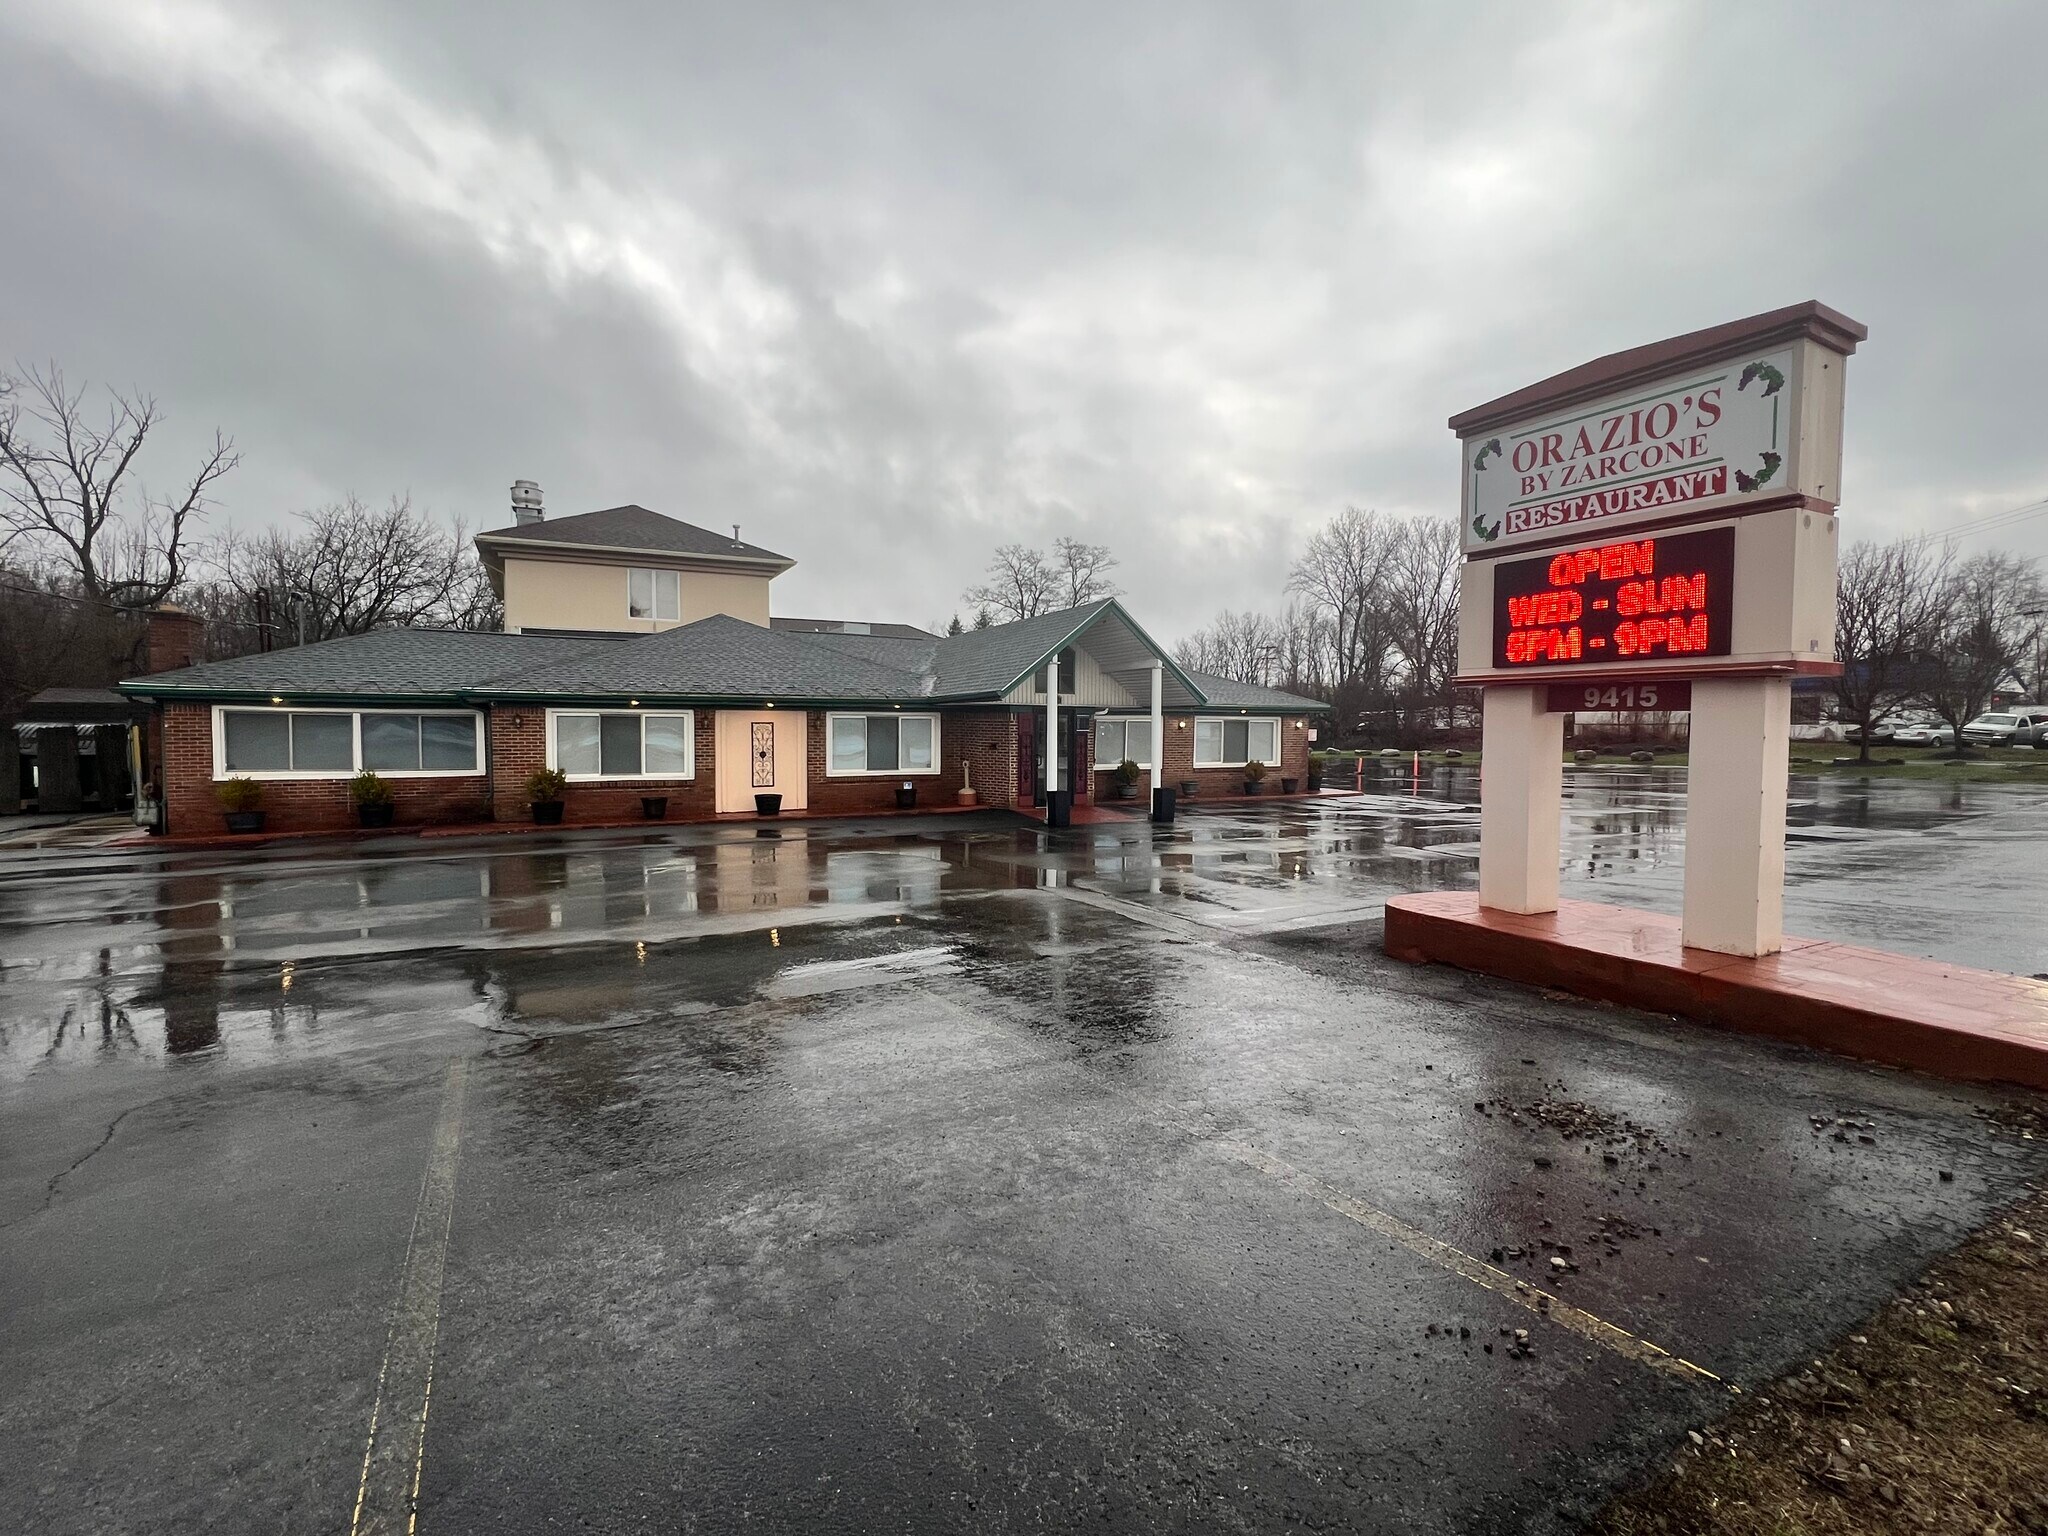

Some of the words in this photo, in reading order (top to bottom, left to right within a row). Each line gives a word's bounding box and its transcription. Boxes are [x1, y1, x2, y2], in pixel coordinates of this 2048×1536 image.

[1512, 387, 1721, 473] ORAZIO'S
[1520, 469, 1554, 496] BY
[1560, 433, 1708, 487] ZARCONE
[1508, 467, 1722, 533] RESTAURANT
[1548, 539, 1654, 587] OPEN
[1508, 590, 1583, 627] WED
[1616, 573, 1706, 616] SUN
[1613, 614, 1708, 655] 9PM
[1584, 686, 1658, 708] 9415
